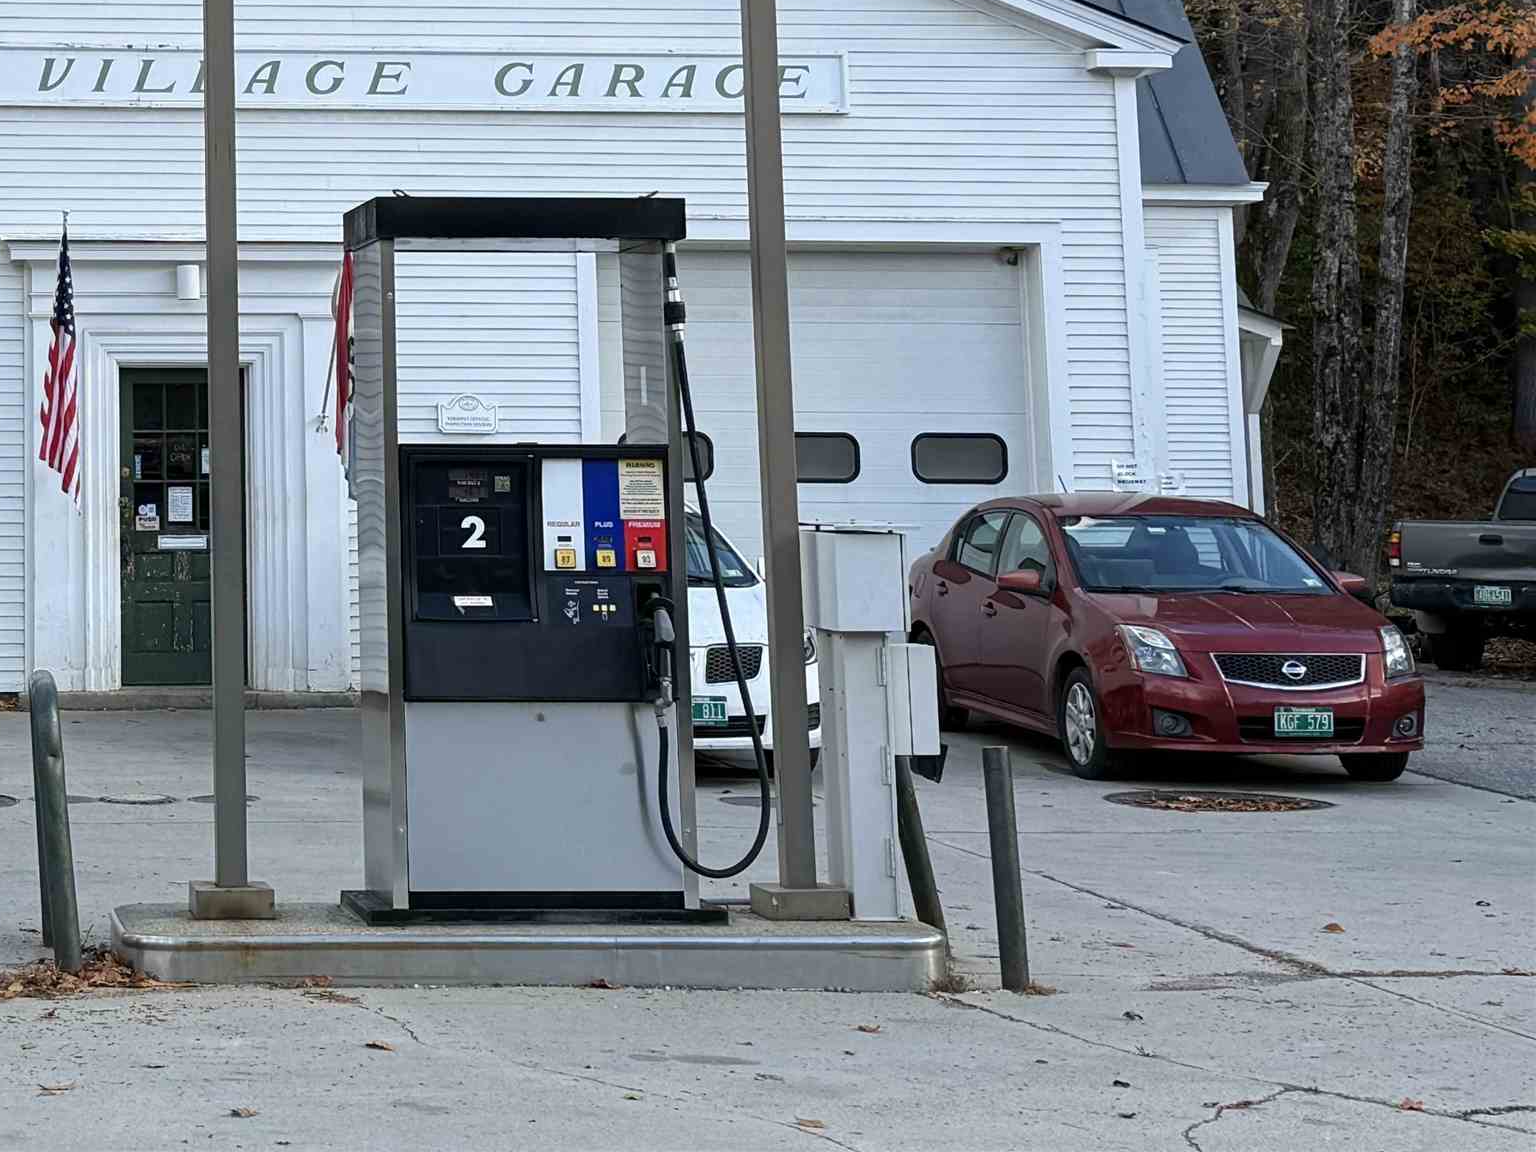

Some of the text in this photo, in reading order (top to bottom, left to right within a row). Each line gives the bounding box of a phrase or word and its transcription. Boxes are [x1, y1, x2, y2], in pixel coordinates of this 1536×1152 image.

[493, 61, 812, 100] GARAGE
[460, 515, 487, 549] 2
[1279, 714, 1330, 730] KGF 579
